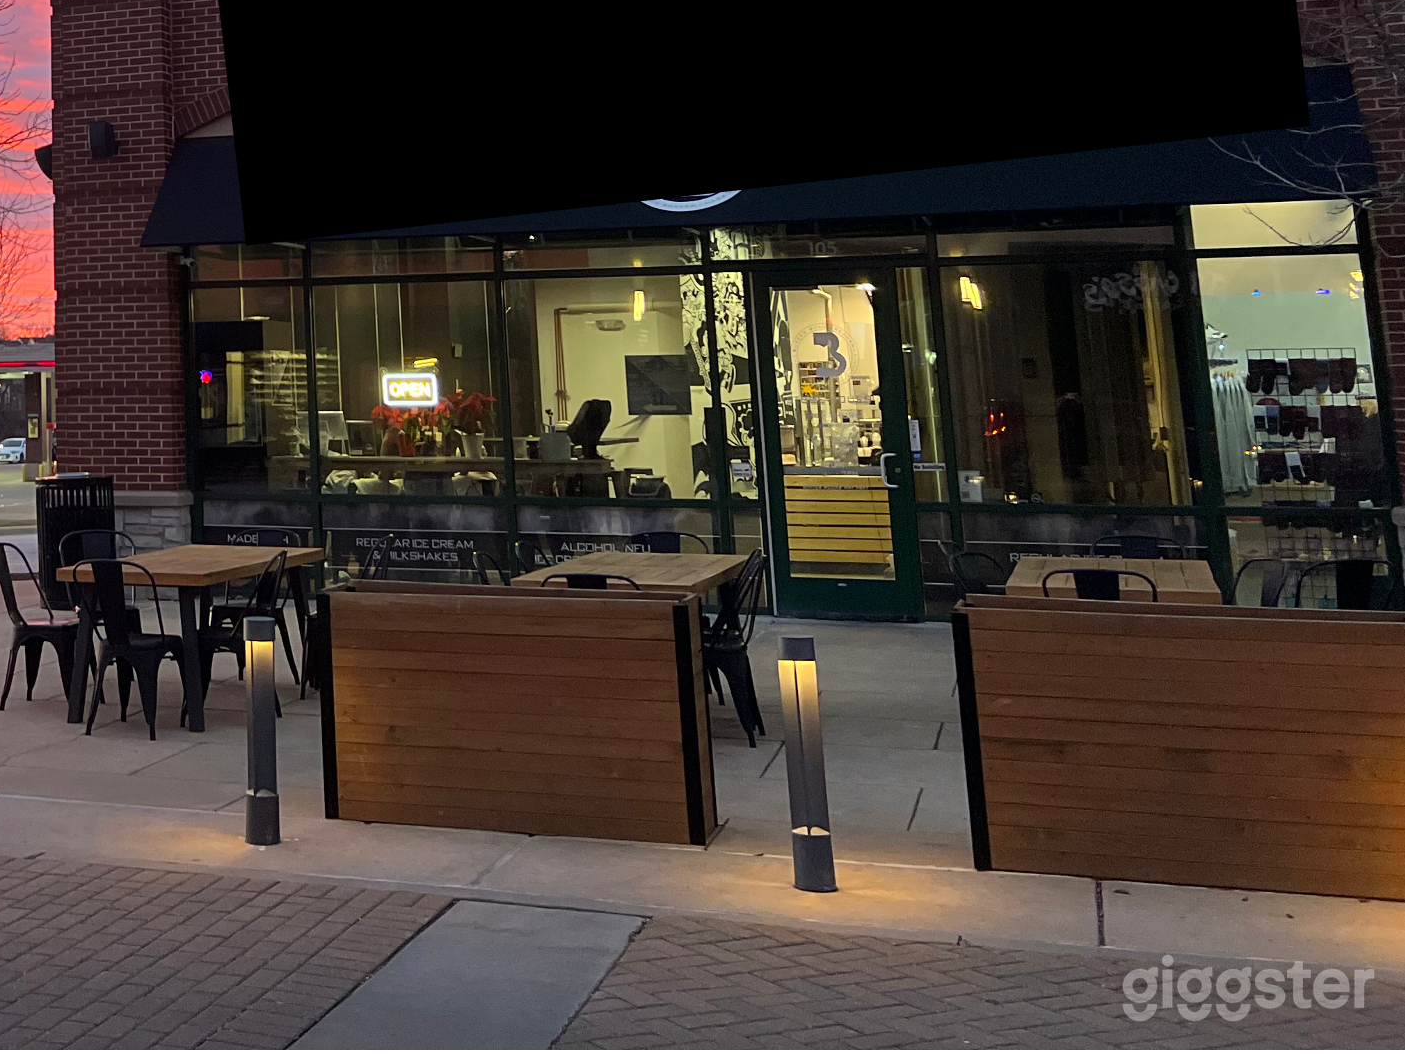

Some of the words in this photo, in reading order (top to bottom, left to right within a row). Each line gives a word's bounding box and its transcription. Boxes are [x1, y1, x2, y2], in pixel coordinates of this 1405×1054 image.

[808, 240, 838, 256] 105
[389, 380, 432, 398] OPEN
[227, 534, 257, 544] MADE
[355, 537, 411, 548] REGUAR
[412, 538, 429, 548] ICE
[432, 539, 474, 550] CREAM
[561, 542, 619, 553] ALCOHOL
[372, 549, 381, 559] &
